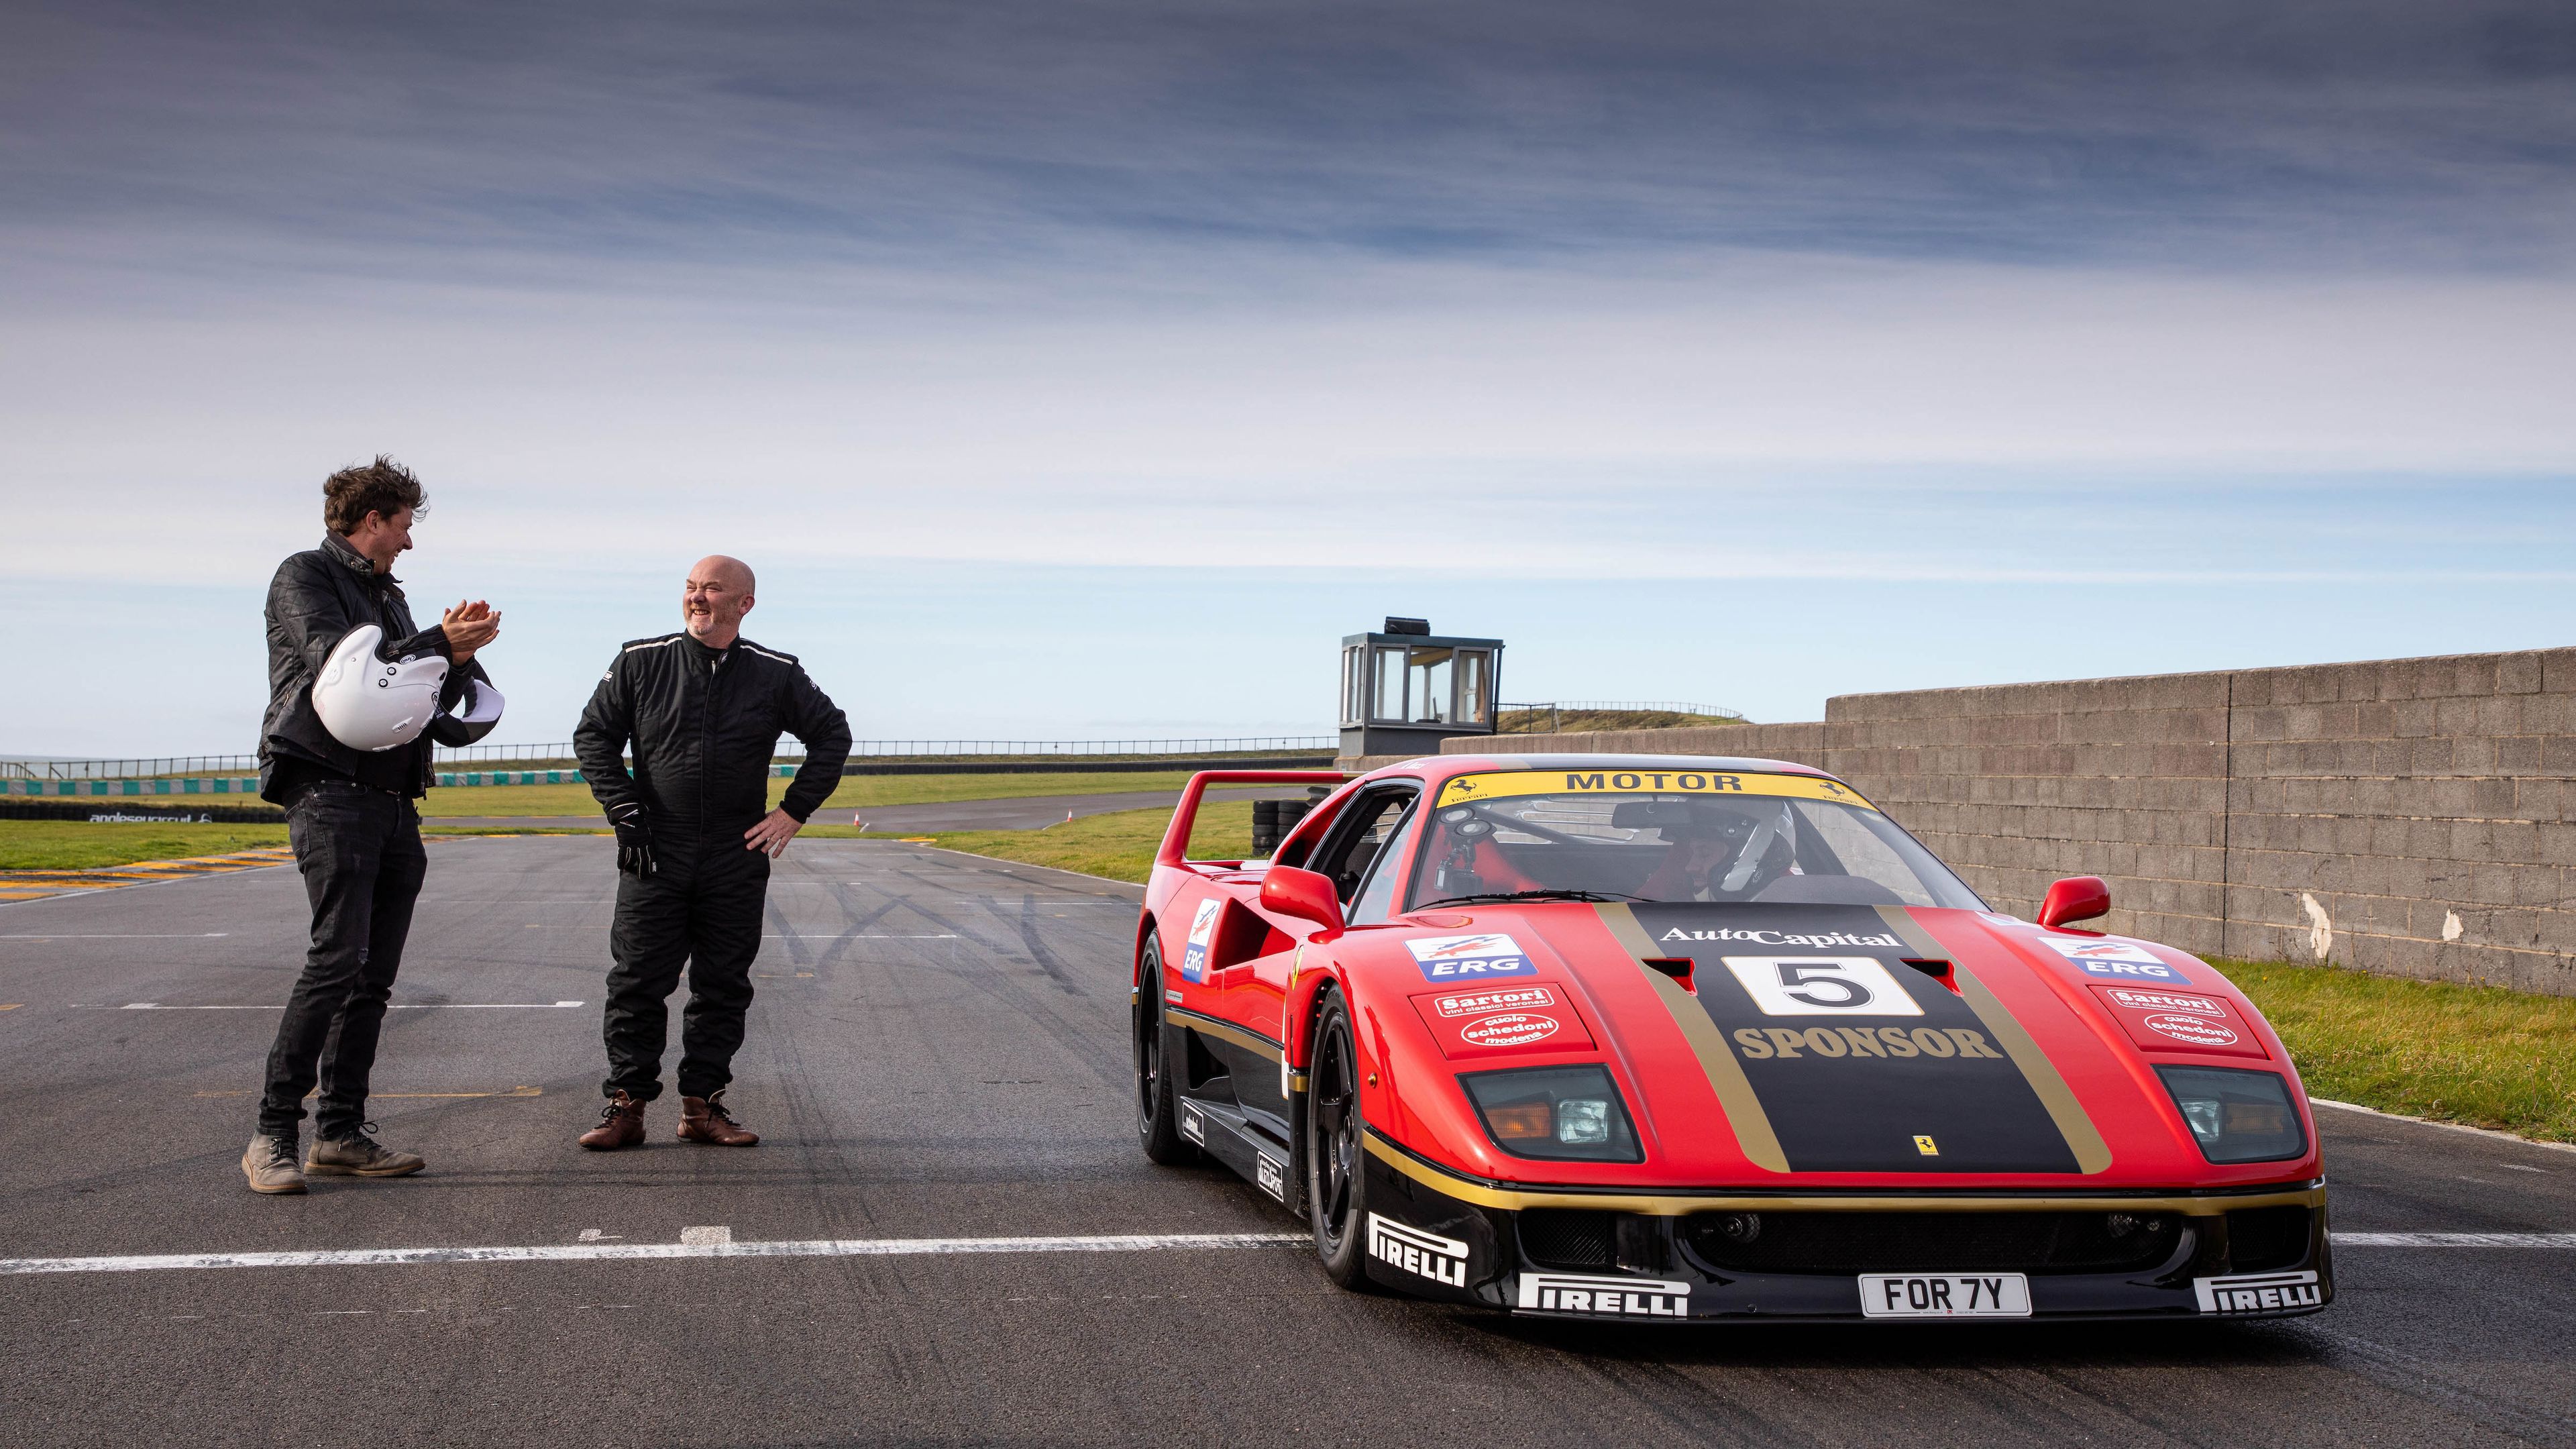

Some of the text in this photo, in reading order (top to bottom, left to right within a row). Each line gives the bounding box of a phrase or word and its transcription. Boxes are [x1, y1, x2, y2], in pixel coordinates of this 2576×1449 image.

[1566, 773, 1743, 792] MOTOR
[1660, 927, 1903, 948] AutoCapital
[1184, 949, 1204, 972] ERG
[1432, 958, 1520, 976] ERG
[2086, 961, 2170, 977] ERG
[1773, 961, 1875, 1010] 5
[1442, 990, 1546, 1010] Sartori
[1445, 999, 1549, 1016] vini classici veronesi
[2116, 990, 2216, 1010] Sartori
[2180, 1006, 2220, 1015] veronesi
[1467, 1021, 1554, 1038] schedoni
[1485, 1015, 1527, 1026] cuoio
[2151, 1022, 2233, 1038] schedoni
[2164, 1016, 2204, 1026] cuoio
[1485, 1032, 1543, 1044] modena
[1733, 1027, 2004, 1059] SPONSOR
[2171, 1032, 2225, 1044] modena
[1368, 1211, 1469, 1288] PIRELLI
[1519, 1273, 1691, 1317] PIRELLI
[1884, 1279, 2002, 1310] FOR 7Y
[2193, 1270, 2321, 1312] PIRELLI
